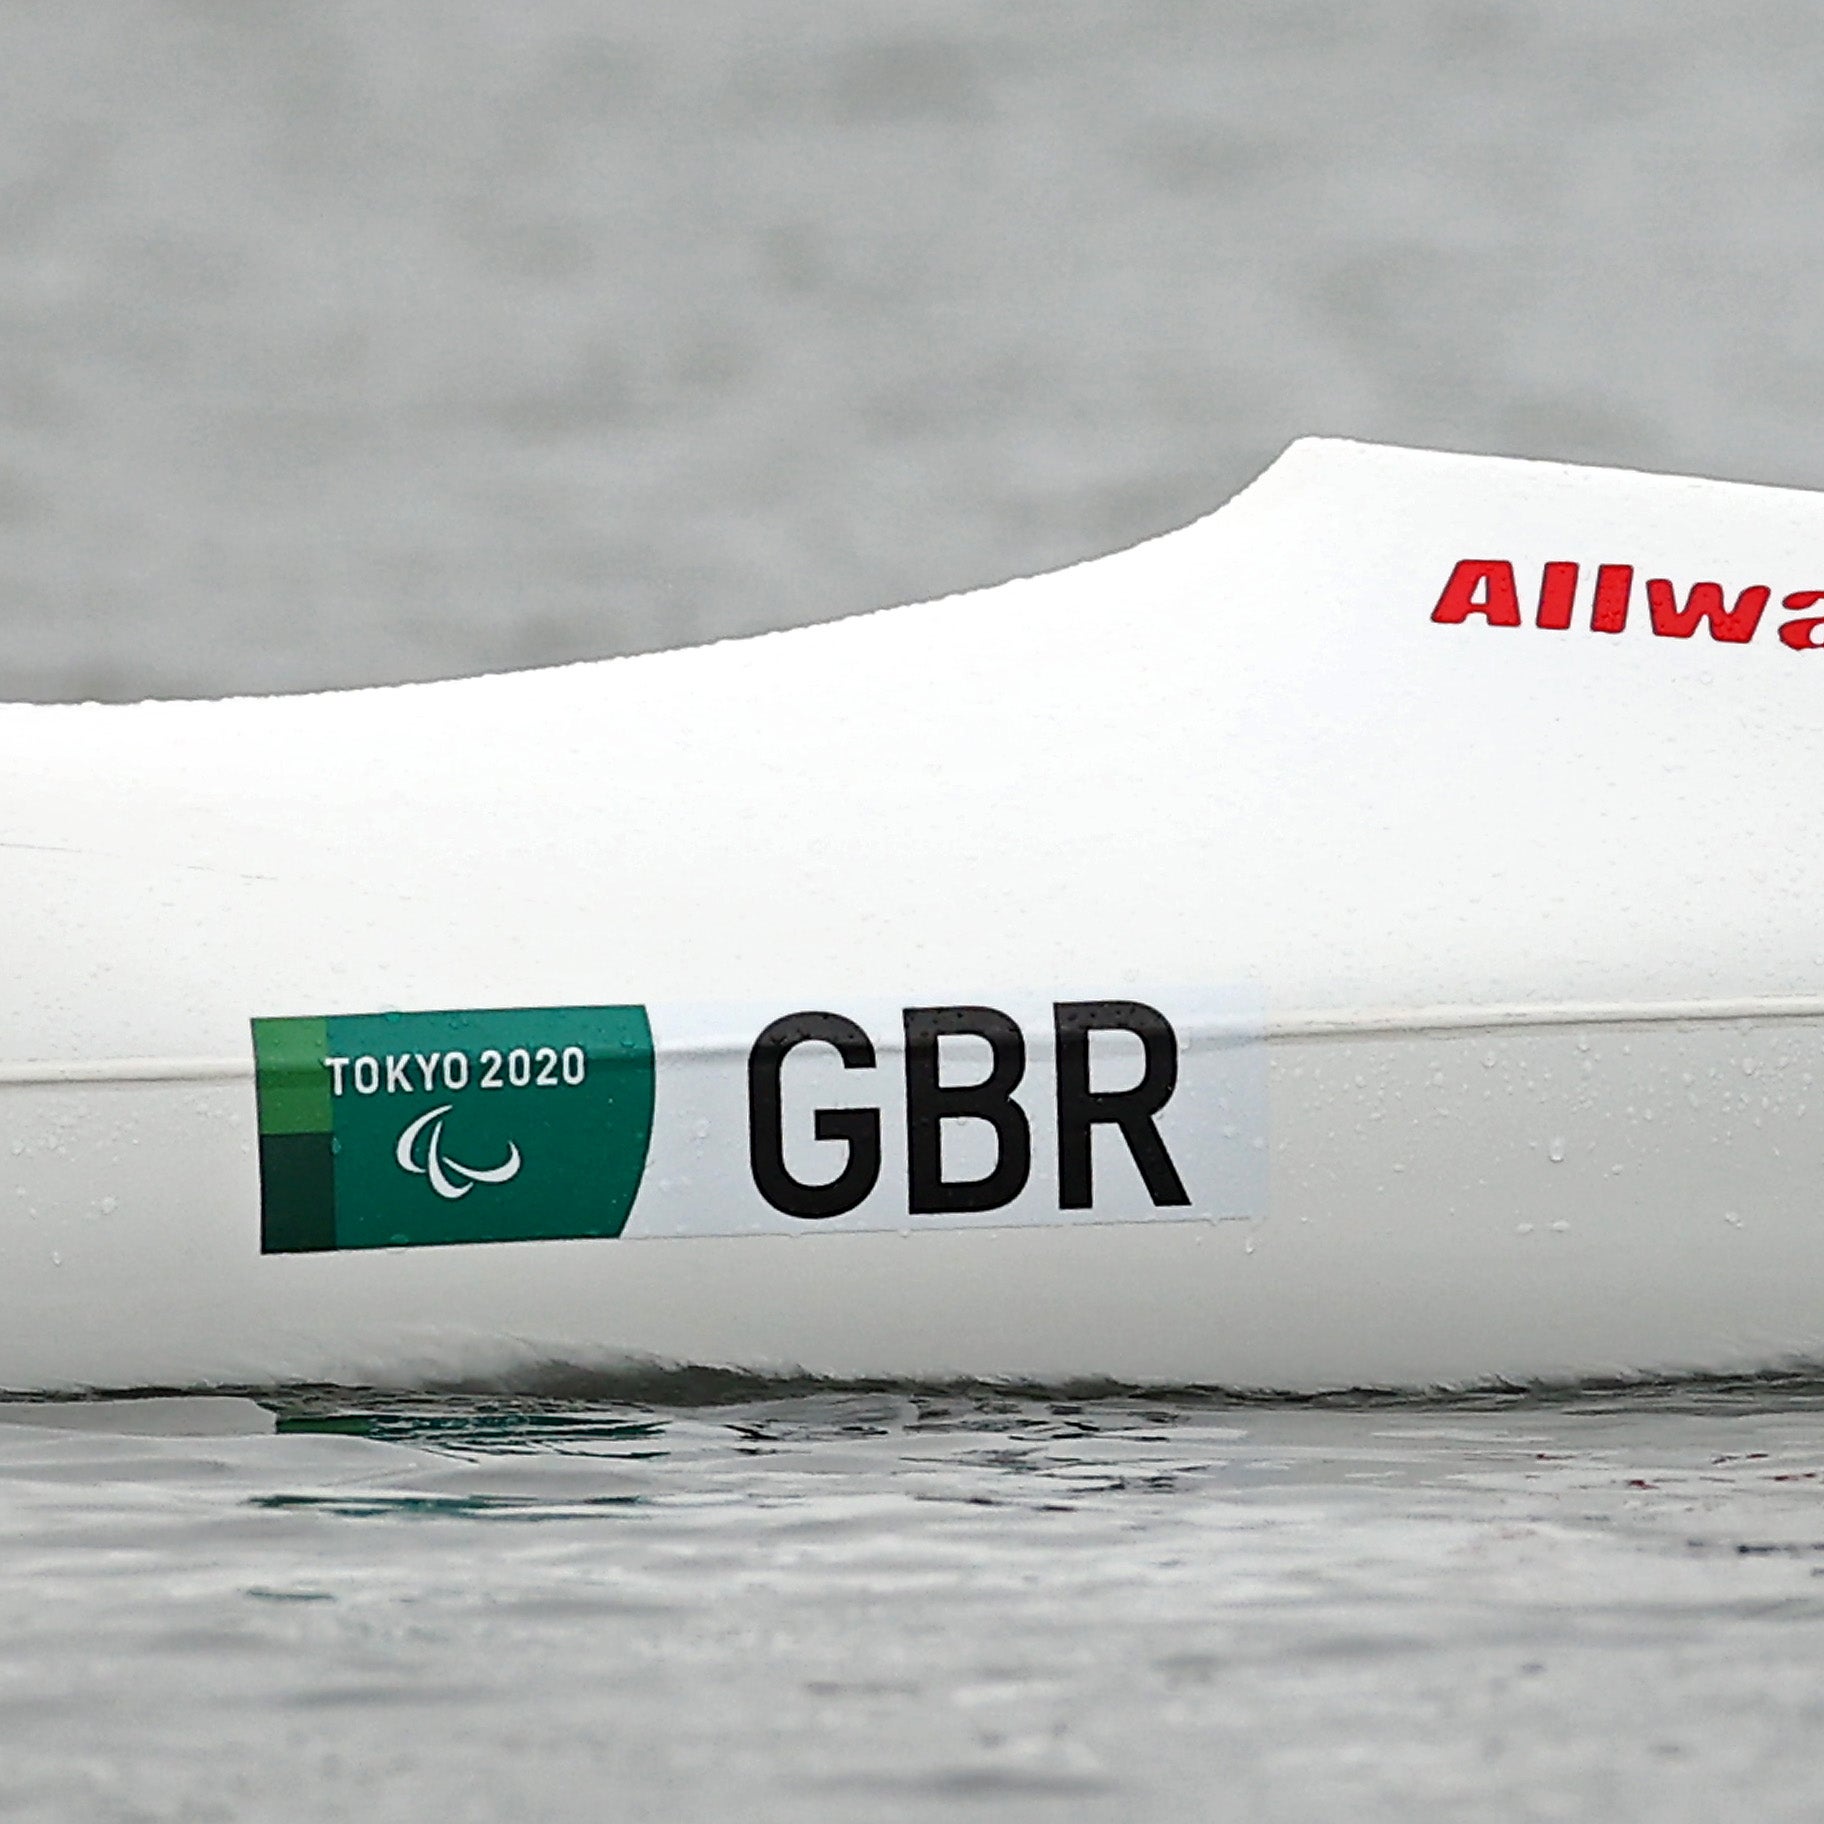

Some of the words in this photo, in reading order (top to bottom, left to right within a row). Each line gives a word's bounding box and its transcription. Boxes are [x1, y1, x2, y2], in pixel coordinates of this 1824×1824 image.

[324, 1050, 469, 1097] TOKYO
[479, 1045, 585, 1088] 2020
[746, 999, 1194, 1221] GBR
